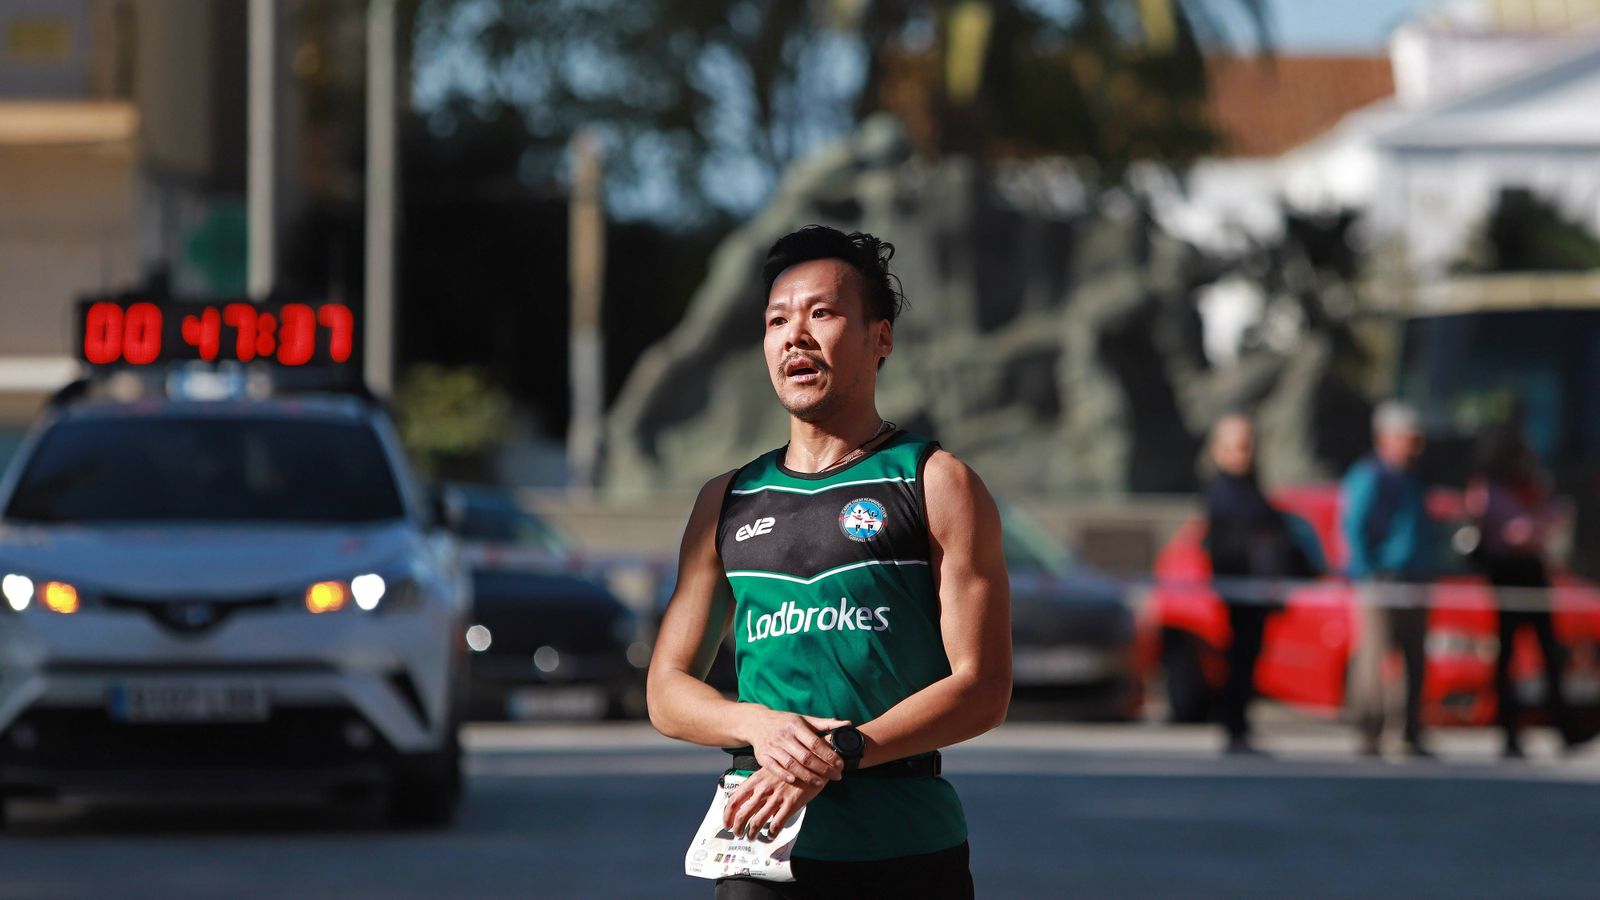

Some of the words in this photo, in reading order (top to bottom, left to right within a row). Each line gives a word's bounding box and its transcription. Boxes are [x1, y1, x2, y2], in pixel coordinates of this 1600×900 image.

[85, 302, 163, 364] 00
[182, 304, 353, 365] 47:37
[747, 597, 890, 643] Ladbrokes
